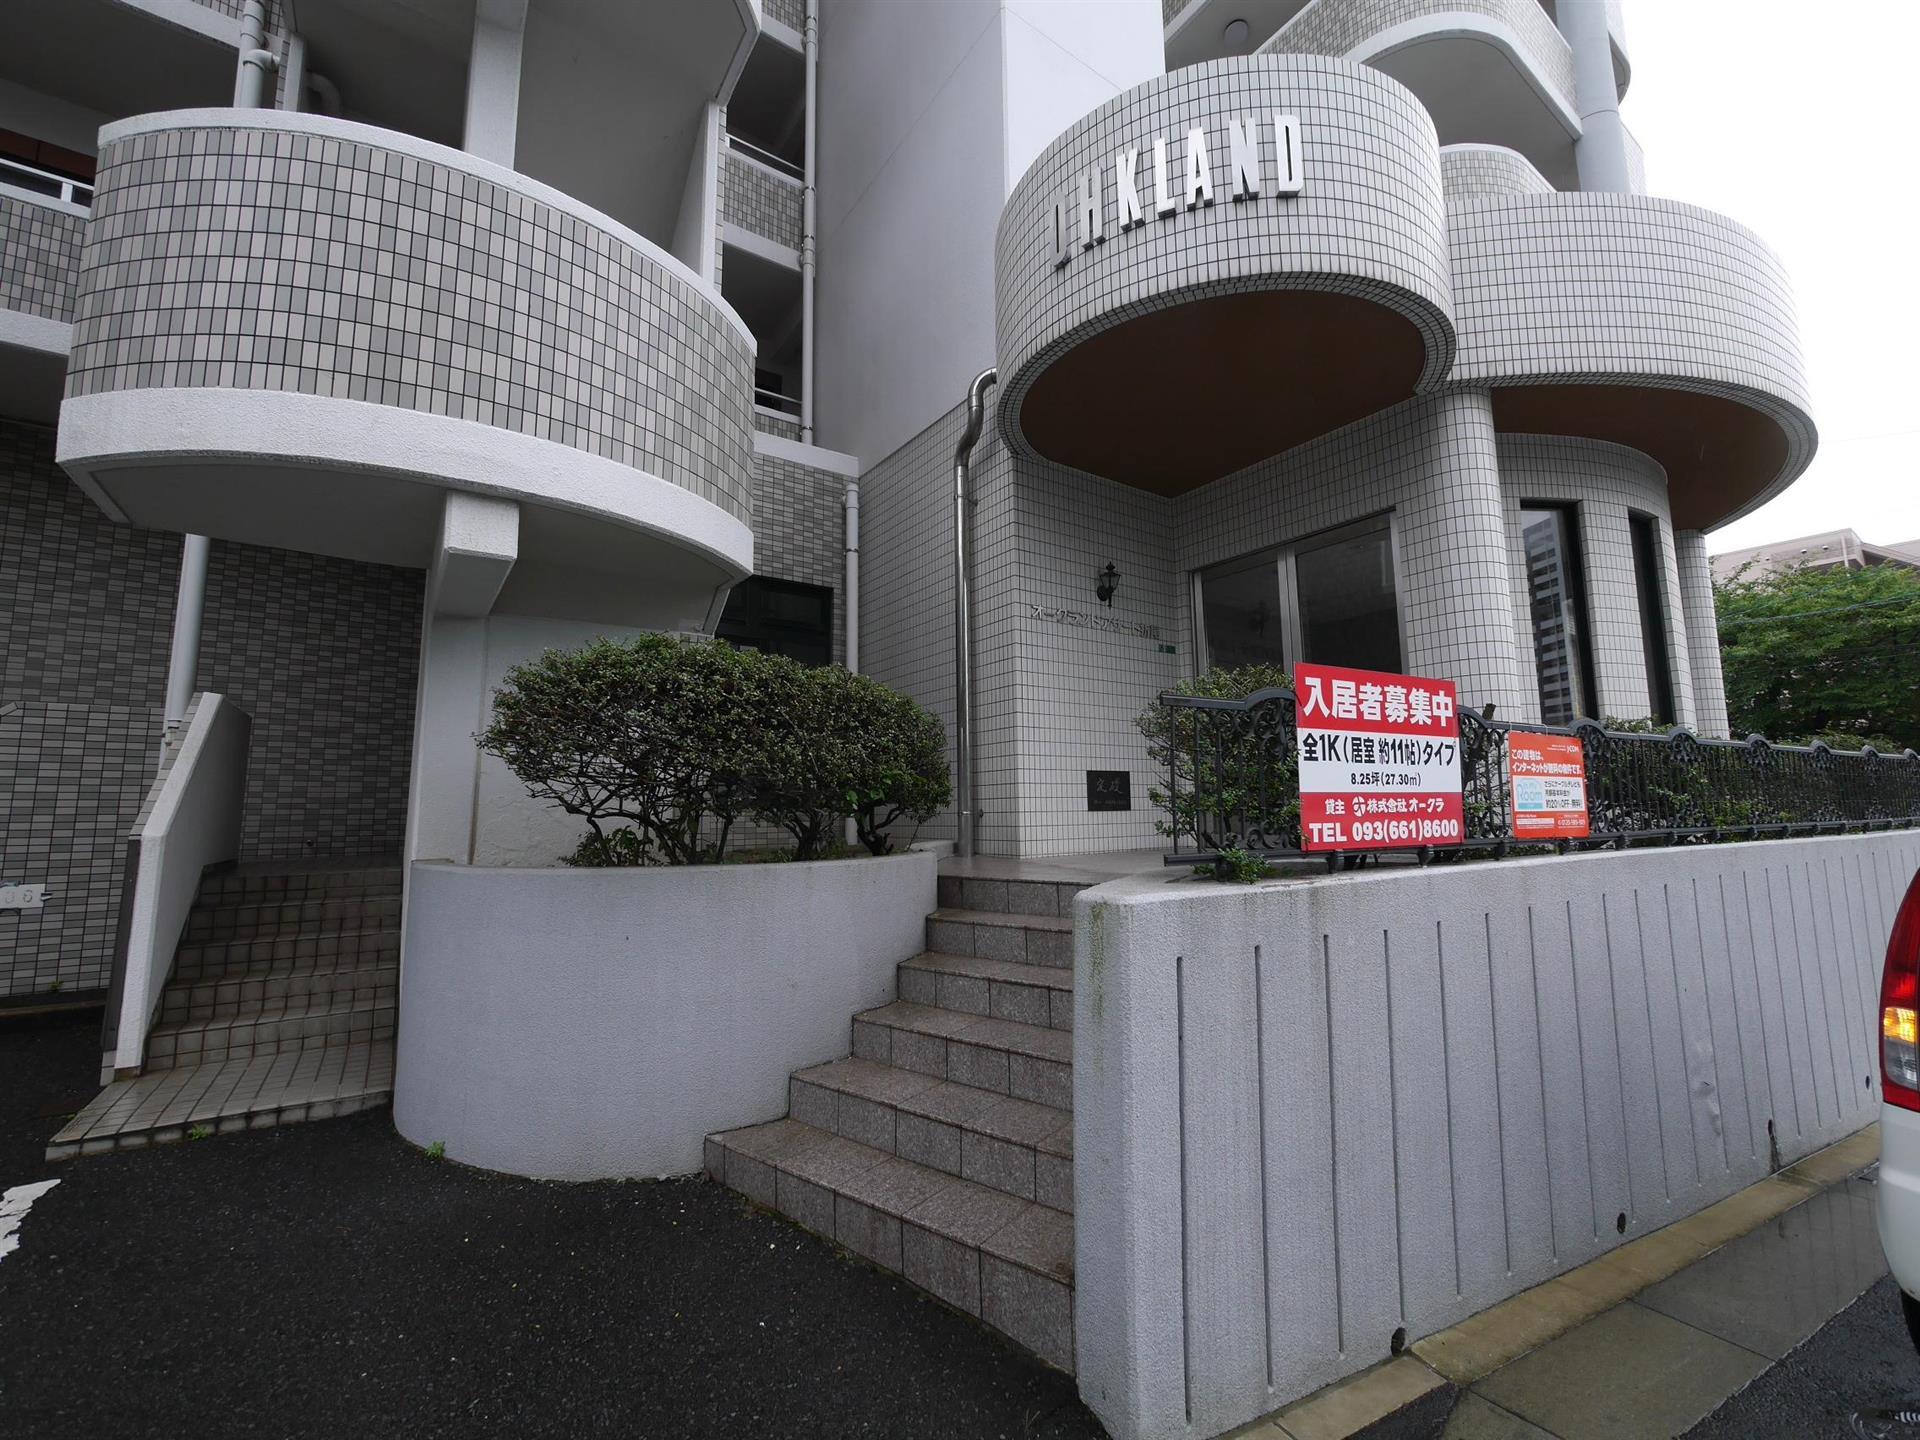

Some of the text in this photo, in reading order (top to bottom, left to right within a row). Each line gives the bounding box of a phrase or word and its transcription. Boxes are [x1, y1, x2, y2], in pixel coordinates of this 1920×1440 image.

[1303, 676, 1454, 727] 入居者募集中
[1325, 799, 1346, 815] 貸主
[1308, 818, 1459, 843] TEL 093(661)8600
